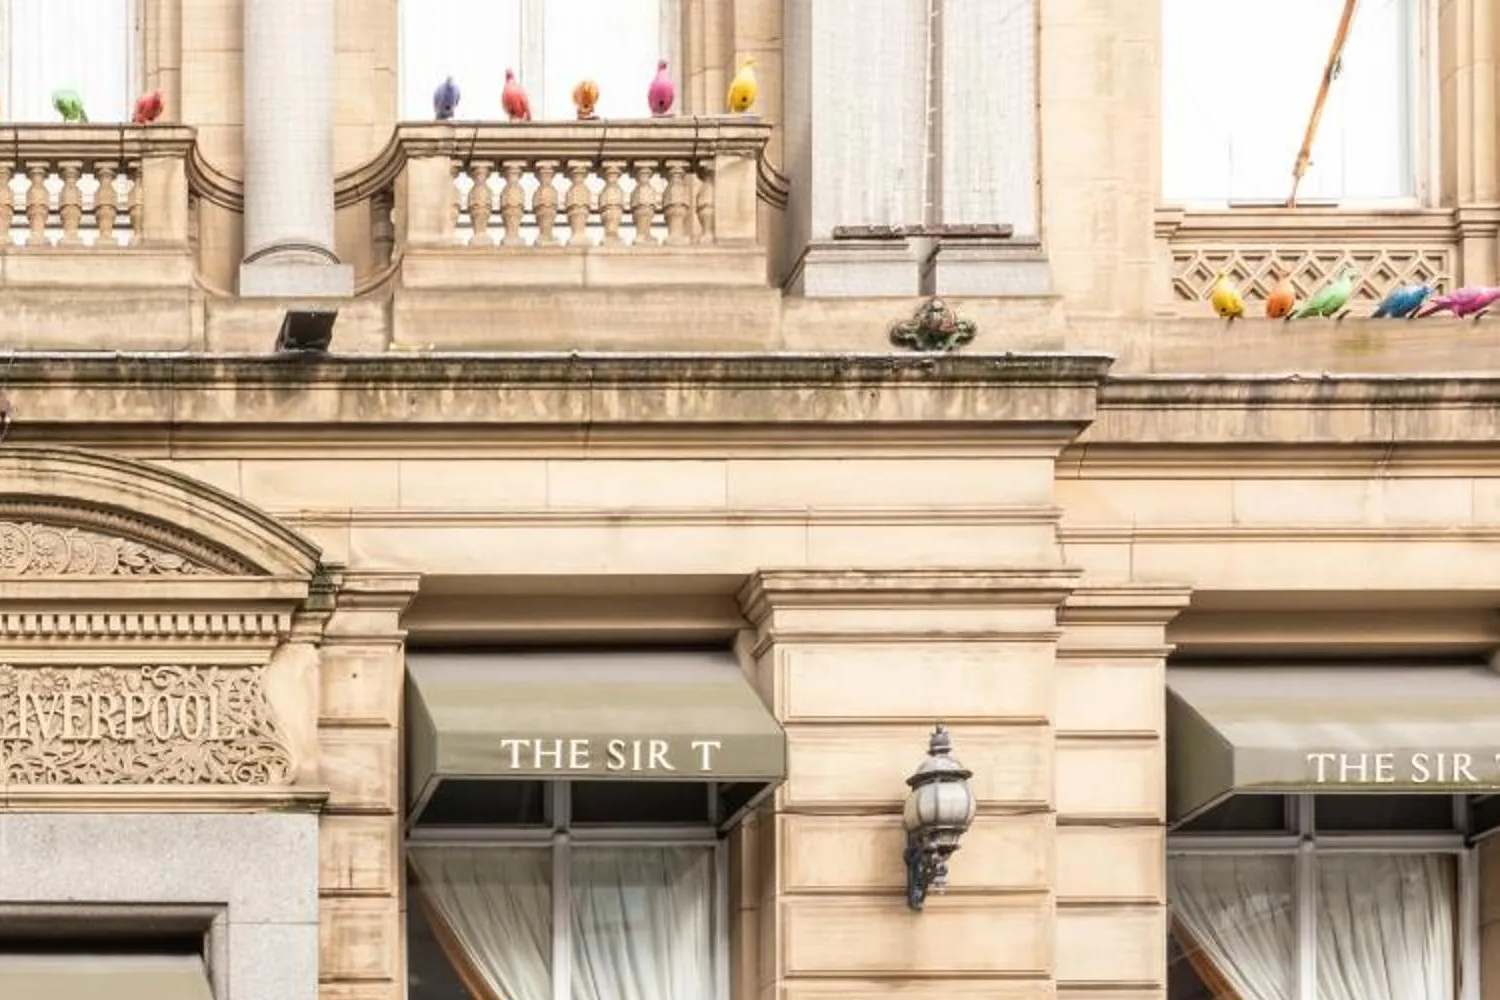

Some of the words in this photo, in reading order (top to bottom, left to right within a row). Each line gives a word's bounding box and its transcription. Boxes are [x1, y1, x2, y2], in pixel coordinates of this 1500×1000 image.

[501, 739, 590, 770] THE
[607, 739, 676, 772] SIR
[692, 740, 722, 772] T
[1307, 753, 1397, 784] THE
[1411, 753, 1481, 784] SIR
